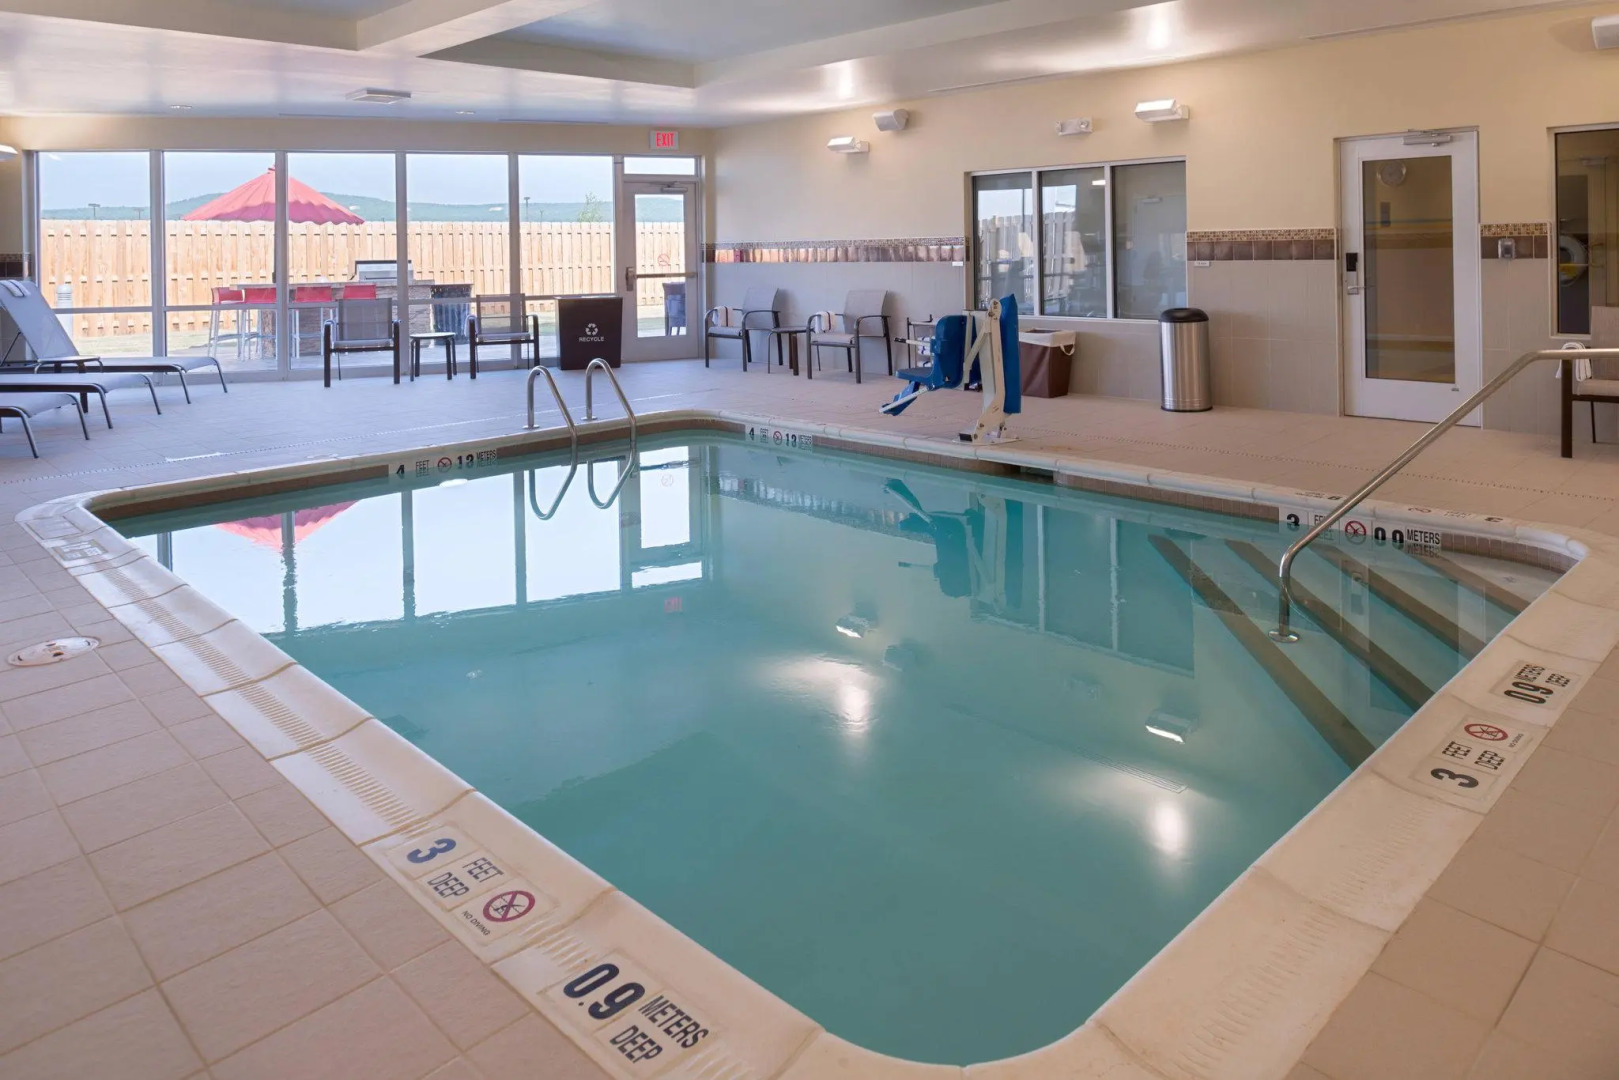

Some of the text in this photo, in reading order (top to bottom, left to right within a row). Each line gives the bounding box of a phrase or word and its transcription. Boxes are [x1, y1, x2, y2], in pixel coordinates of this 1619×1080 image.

[656, 132, 674, 147] EXIT
[1406, 528, 1440, 545] METERS
[1442, 741, 1473, 760] FEET
[1474, 750, 1506, 771] DEEP
[1430, 768, 1479, 788] 3
[407, 838, 457, 864] 3
[462, 857, 504, 883] FEET
[427, 871, 470, 899] DEEP
[461, 910, 491, 936] NO DIVING
[563, 963, 646, 1020] 0.9
[638, 994, 709, 1049] METERS
[609, 1024, 664, 1064] DEEP
